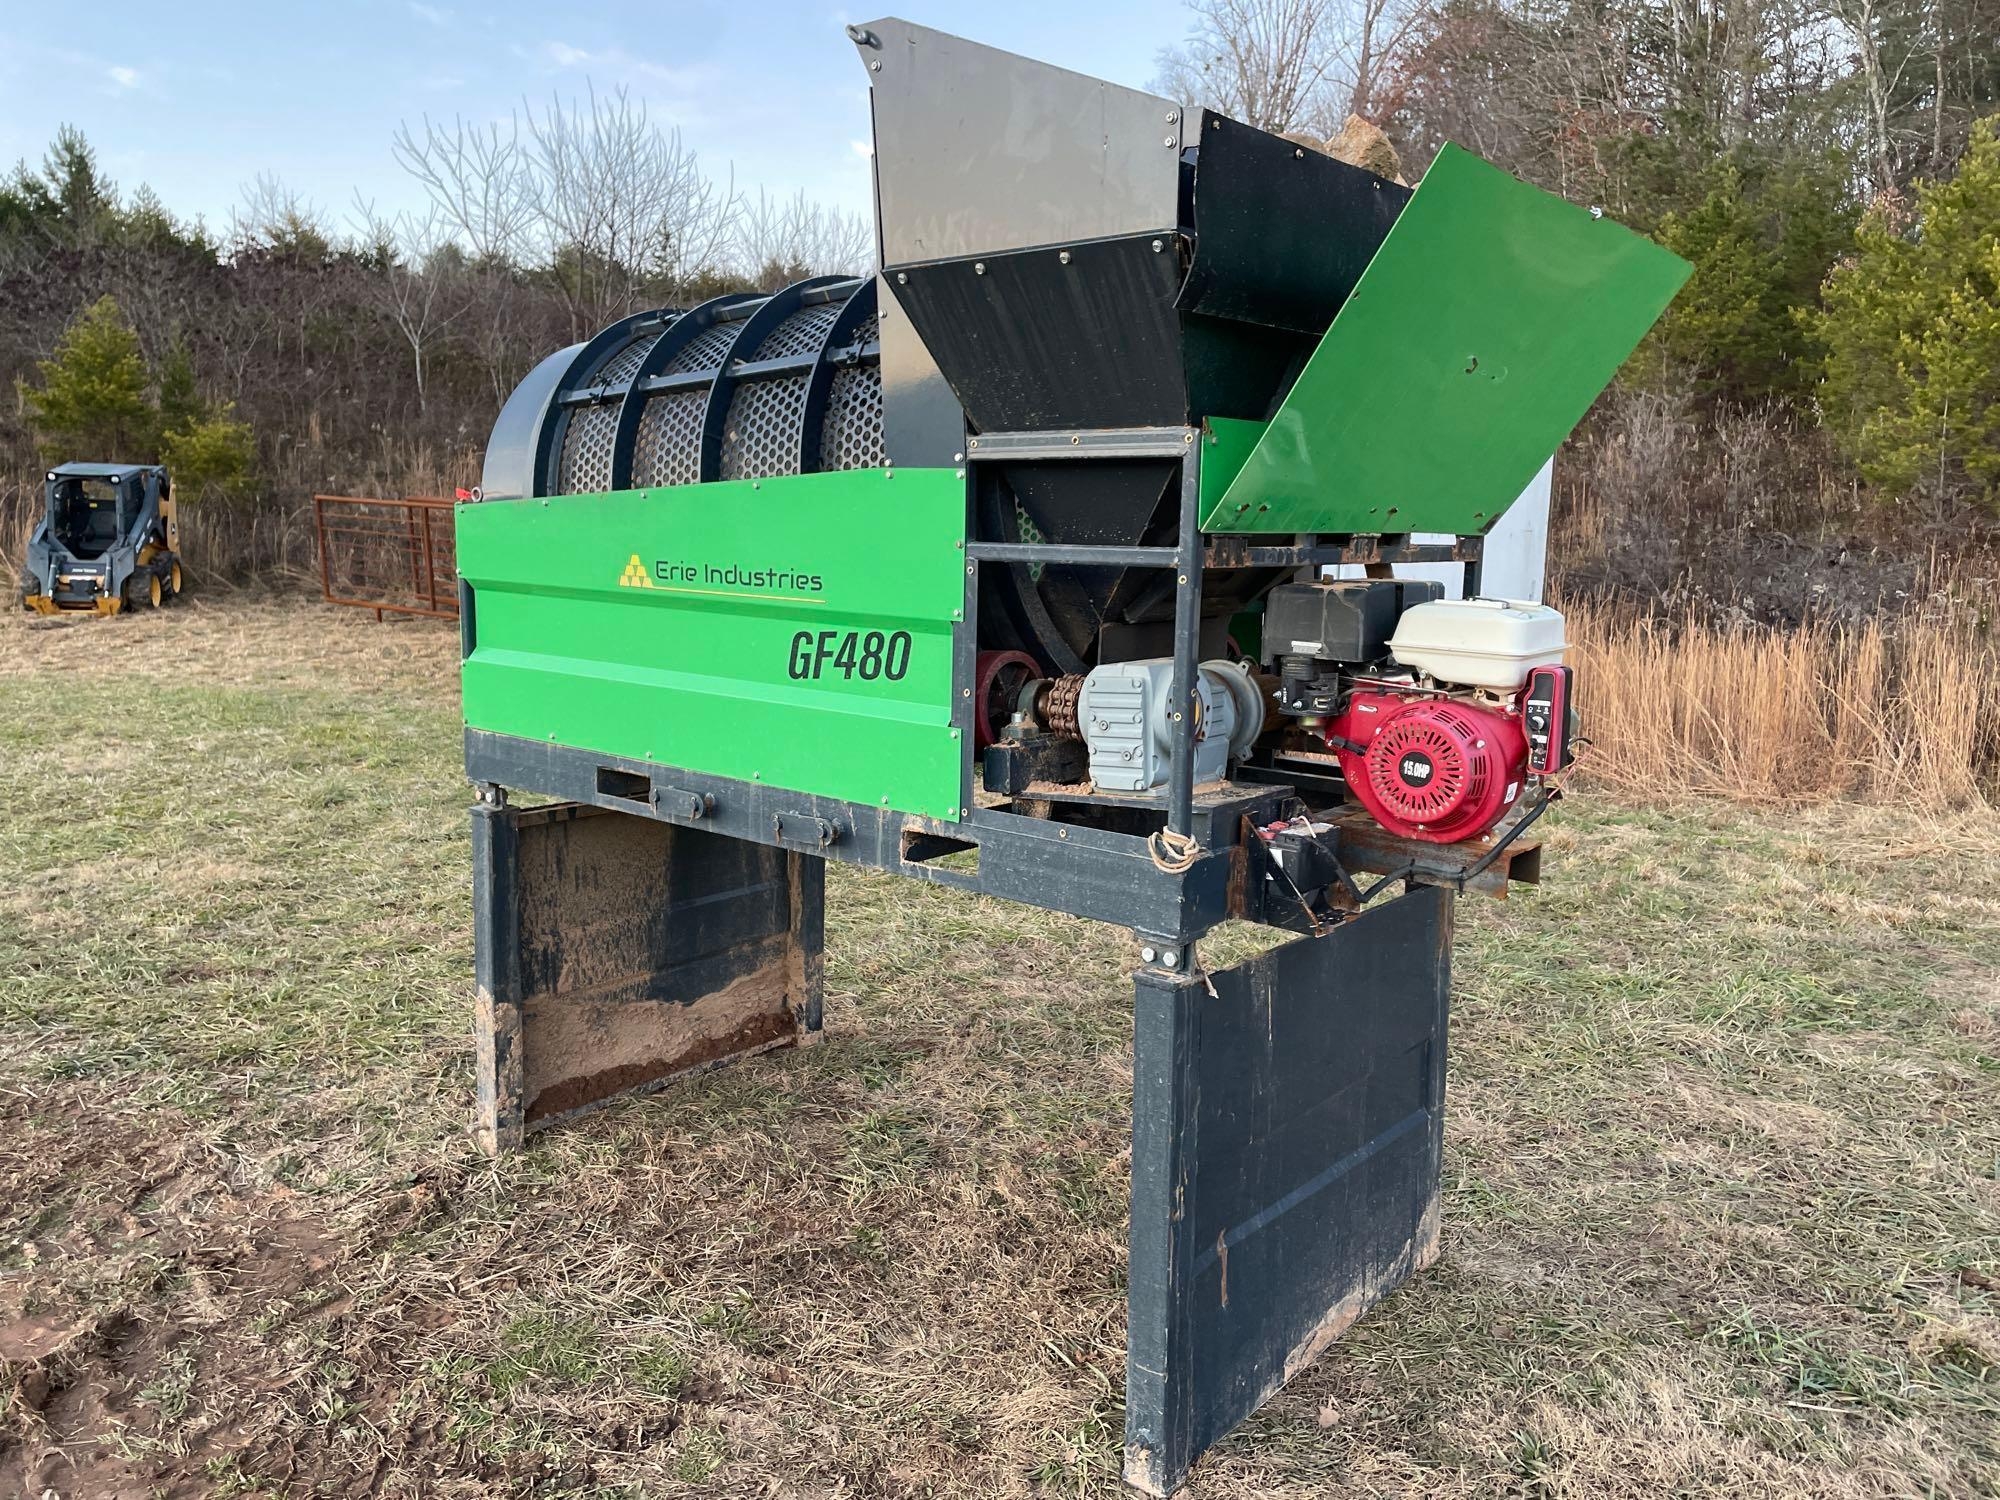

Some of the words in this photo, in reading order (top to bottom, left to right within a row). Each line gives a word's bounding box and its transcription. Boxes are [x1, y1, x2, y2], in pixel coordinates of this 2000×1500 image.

[655, 560, 697, 581] Erie
[704, 563, 823, 591] Industries
[788, 630, 912, 681] GF480
